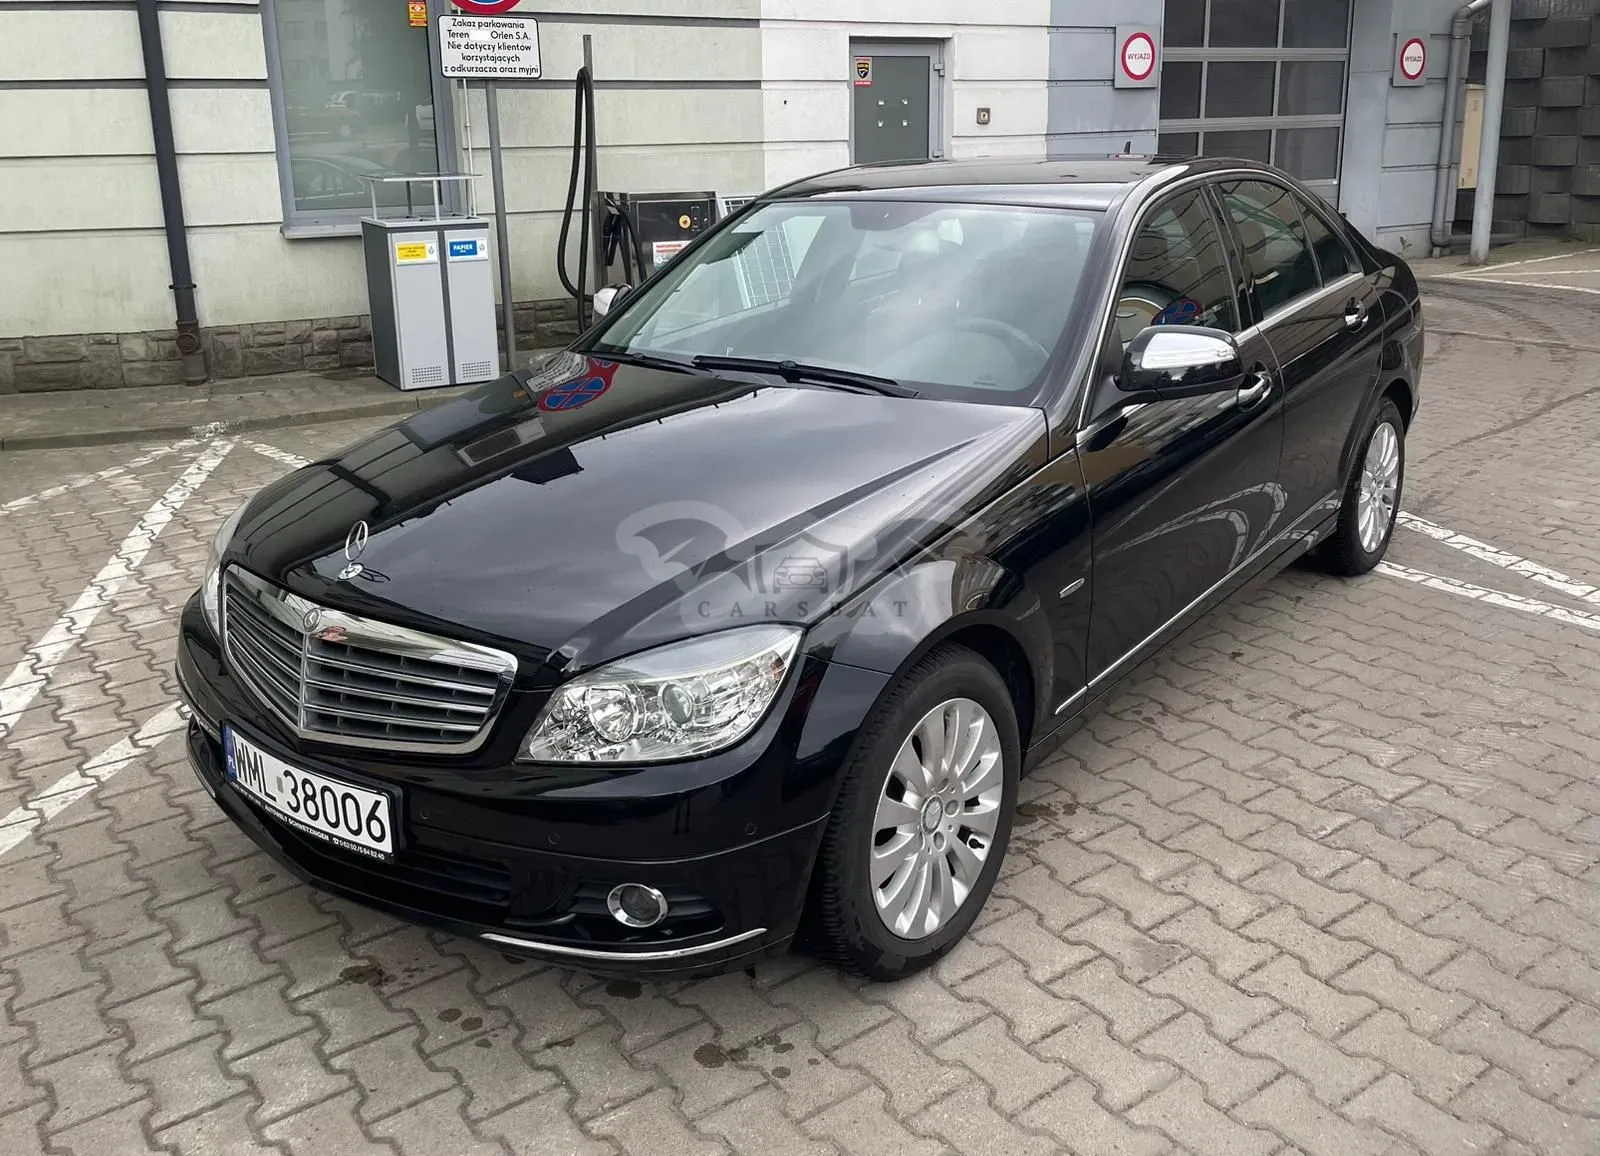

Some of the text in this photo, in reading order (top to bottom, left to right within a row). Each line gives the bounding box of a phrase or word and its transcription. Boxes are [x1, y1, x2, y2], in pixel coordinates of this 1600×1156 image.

[451, 18, 525, 29] Zakaz parkowania
[447, 30, 531, 40] Teren Orlen S.A.
[447, 41, 462, 49] Nie
[463, 41, 496, 52] dotyczy
[461, 53, 521, 64] korzystających
[450, 64, 497, 73] odkurzacza
[518, 65, 539, 75] myjni
[453, 243, 474, 251] PAPIER
[227, 754, 236, 769] PL
[233, 736, 386, 842] WML 38006
